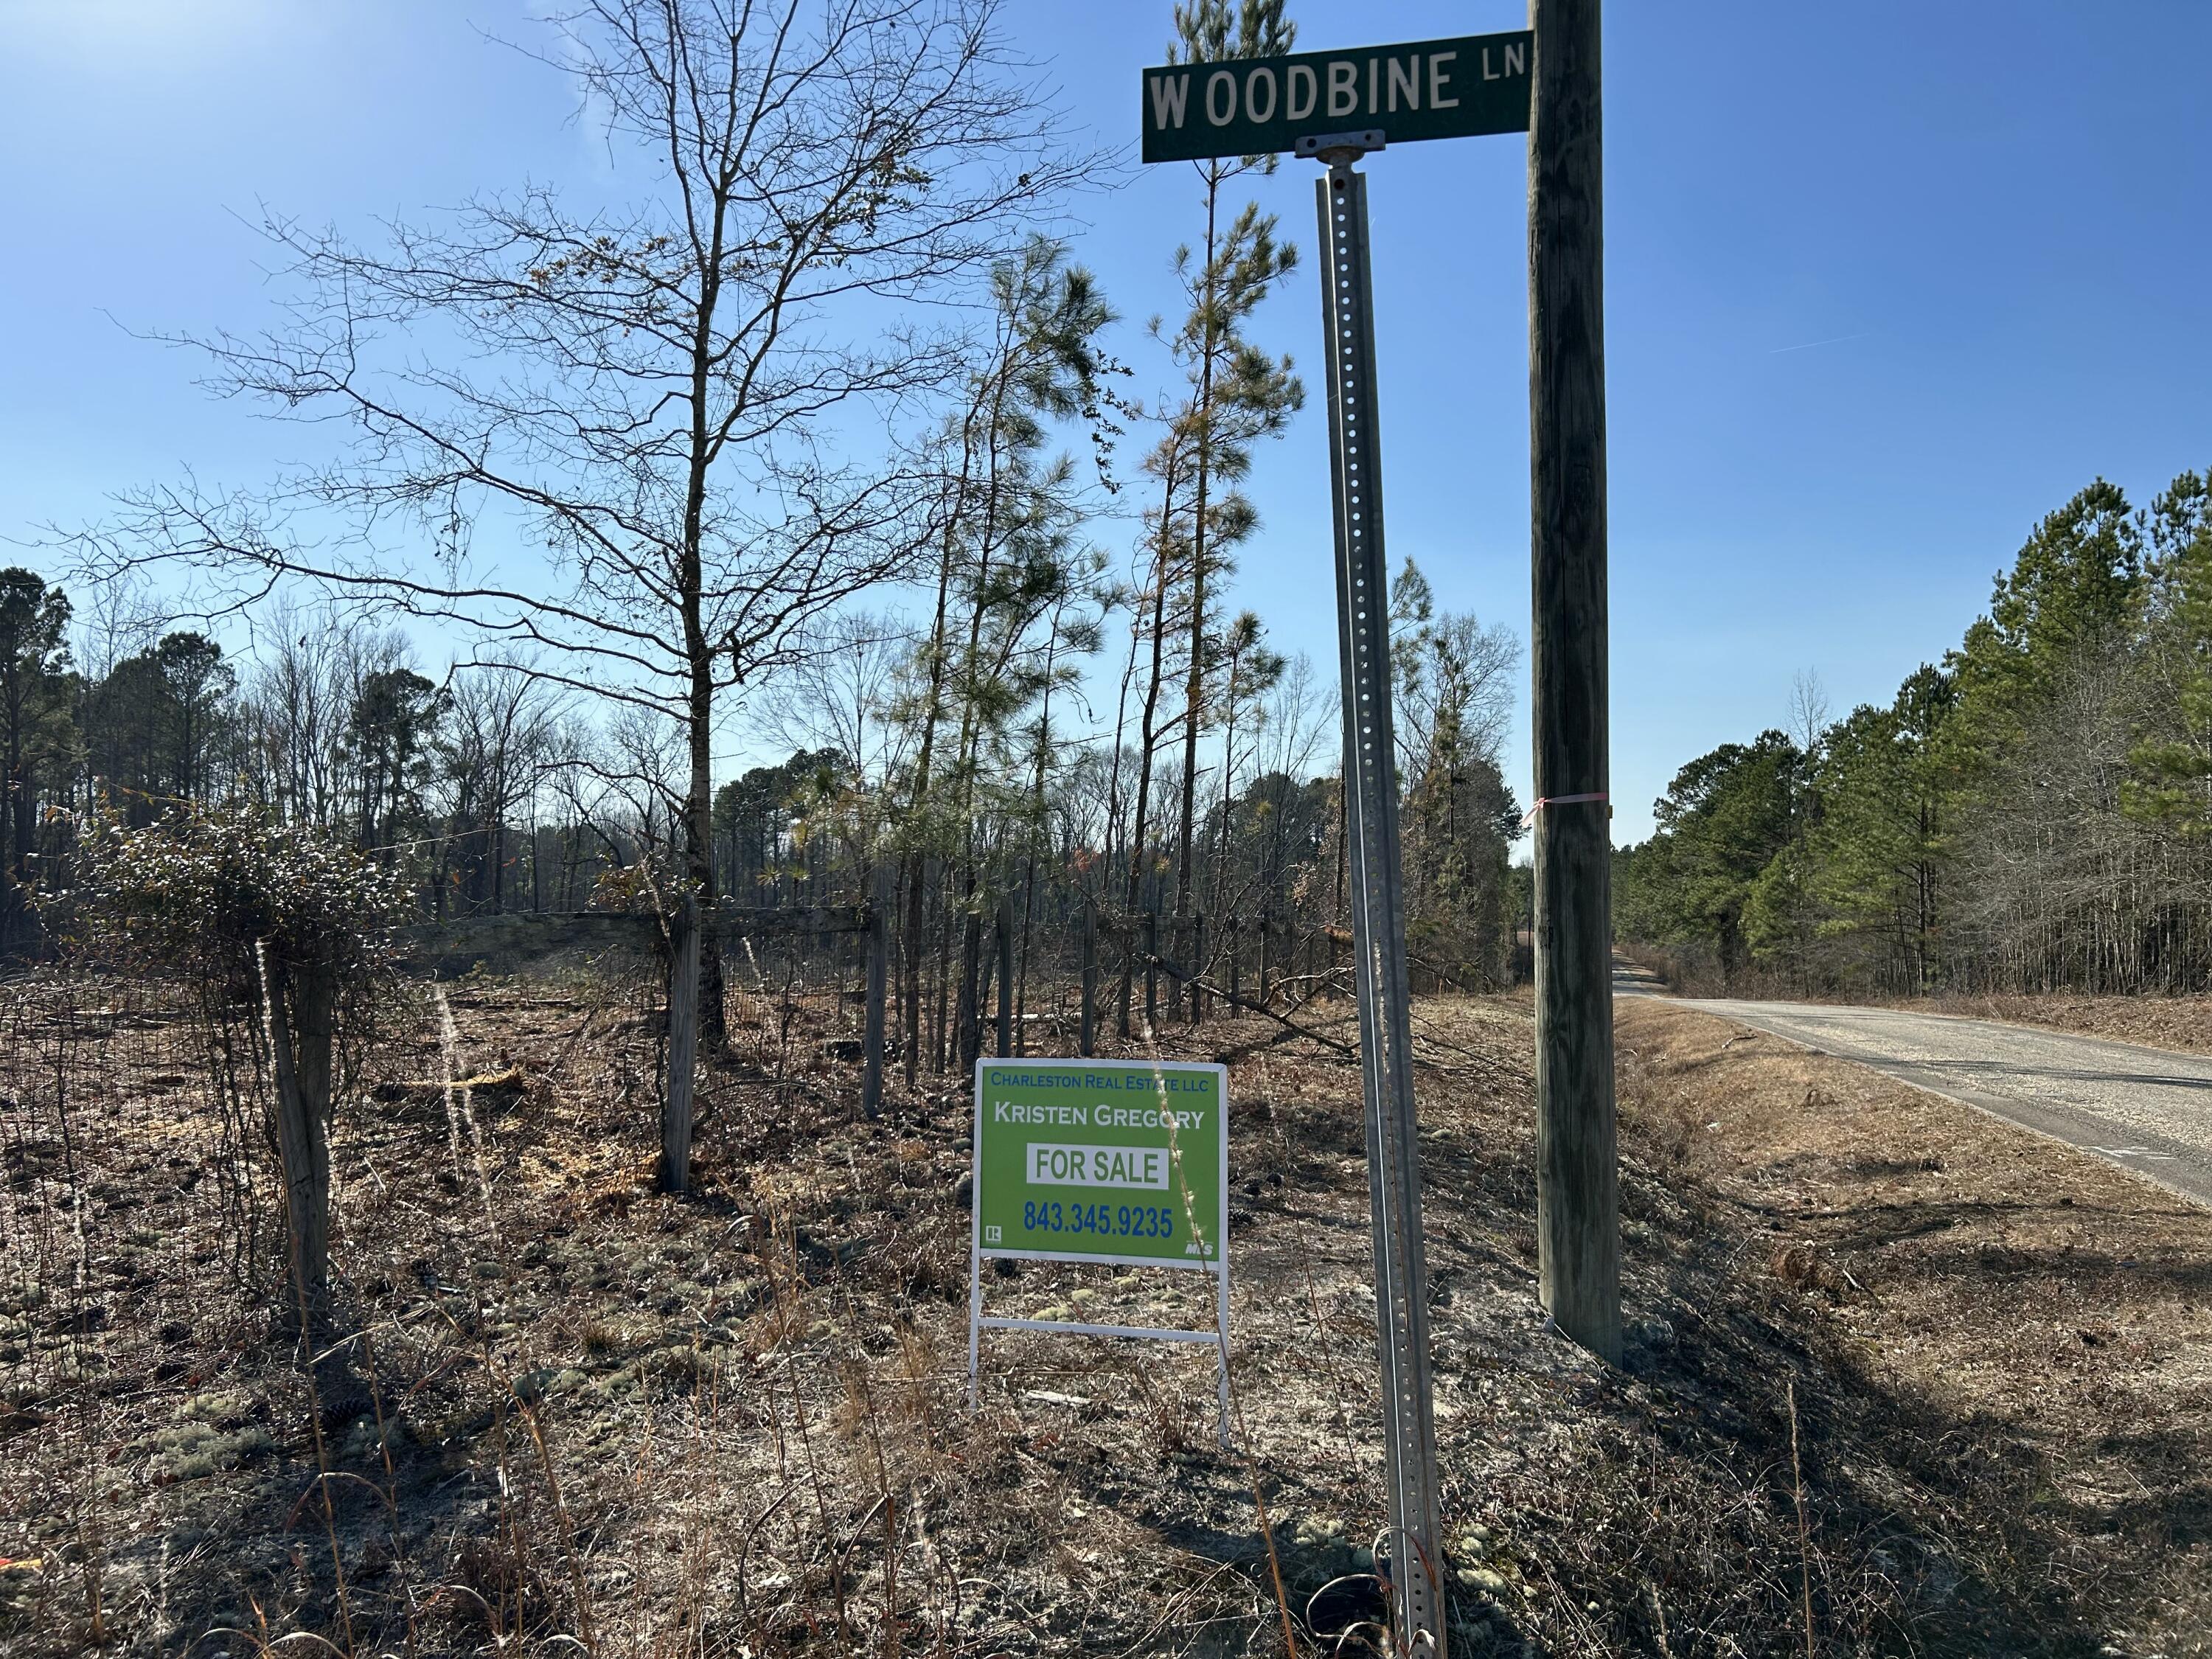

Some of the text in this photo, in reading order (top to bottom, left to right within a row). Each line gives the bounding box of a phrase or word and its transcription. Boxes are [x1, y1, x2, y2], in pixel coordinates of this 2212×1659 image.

[1150, 42, 1525, 130] WOODBINE LN
[991, 1072, 1081, 1088] CHARLESTON
[1085, 1074, 1122, 1089] REAL
[1183, 1079, 1209, 1092] LLC
[995, 1101, 1205, 1130] KRISTEN GREGORY
[1036, 1149, 1159, 1183] FOR SALE
[1023, 1200, 1173, 1238] 843.345.9235
